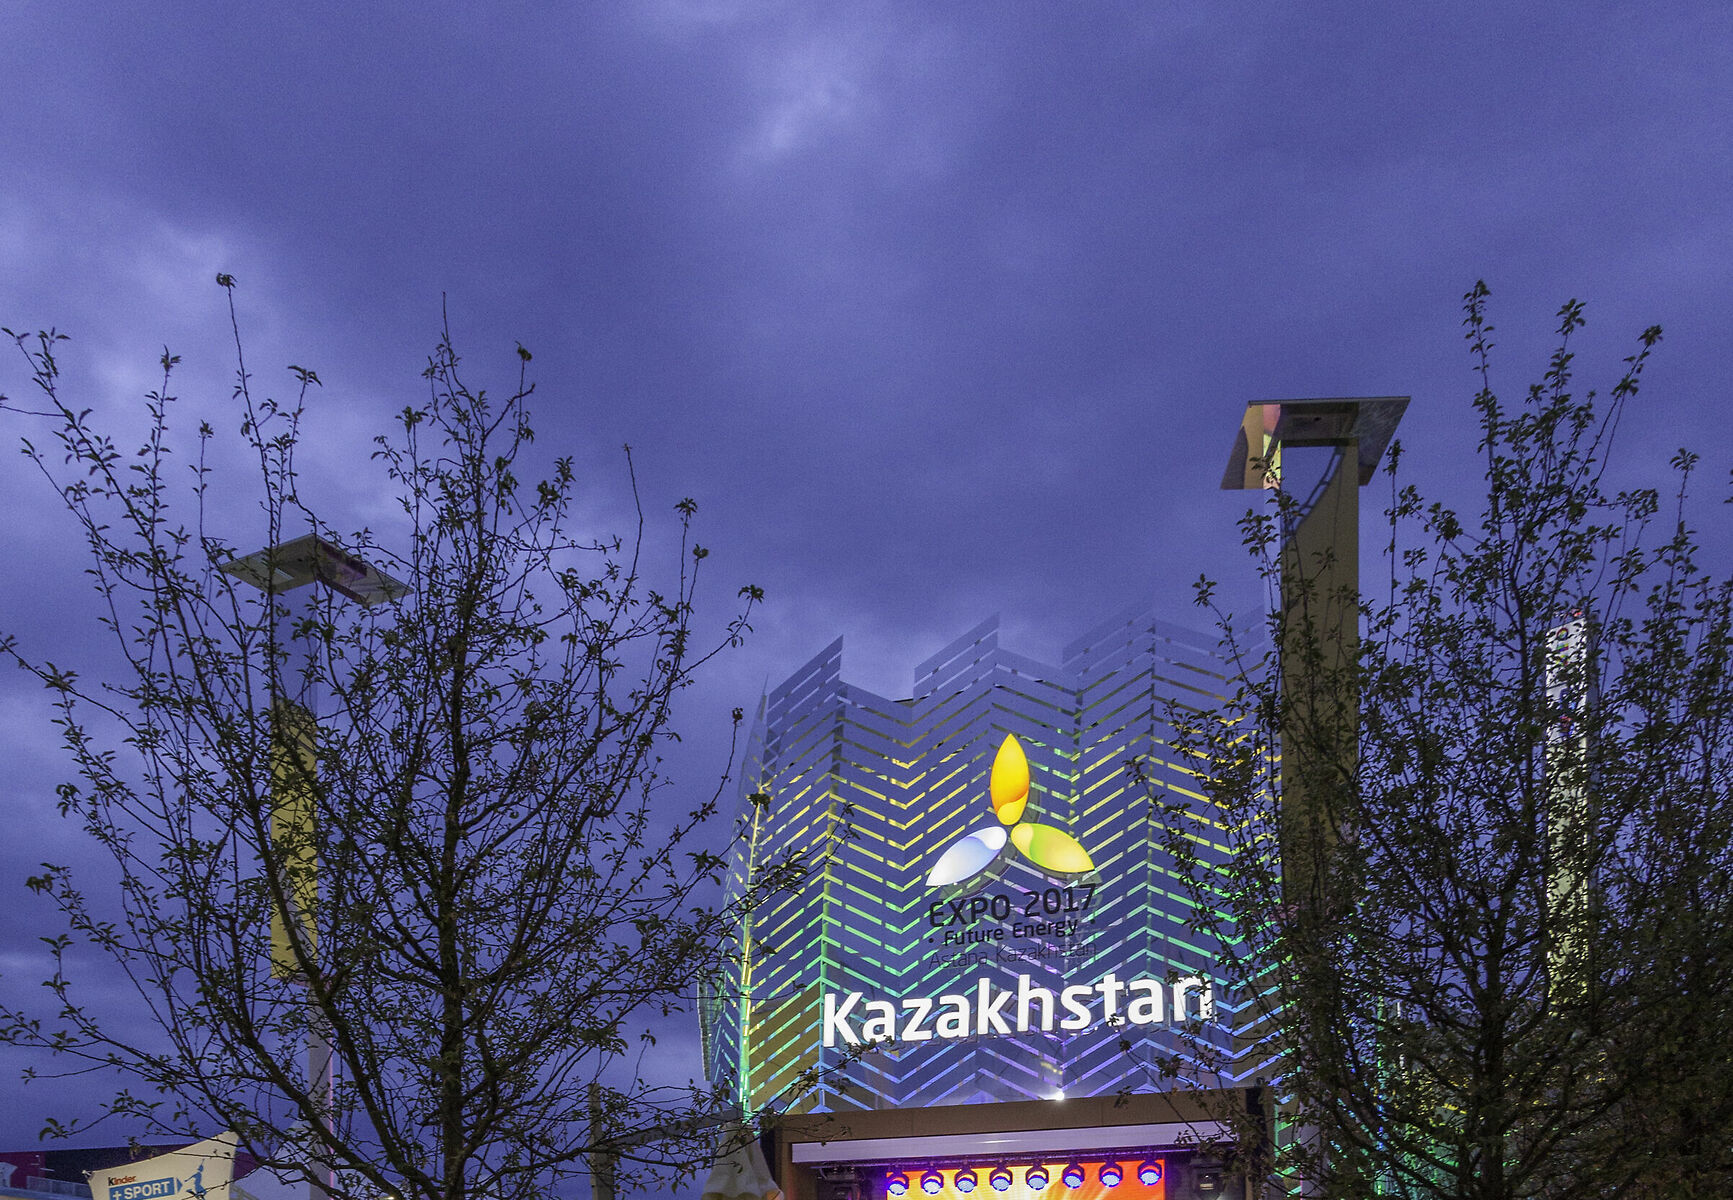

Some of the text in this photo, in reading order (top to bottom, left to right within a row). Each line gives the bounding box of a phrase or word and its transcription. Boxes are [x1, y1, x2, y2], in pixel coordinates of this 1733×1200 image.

[928, 883, 1096, 927] EXPO 2017
[944, 917, 1079, 947] Future Energy
[929, 941, 1097, 970] Astana Kazakhstan
[822, 972, 1213, 1048] Kazakhstan
[124, 1181, 170, 1199] SPORT
